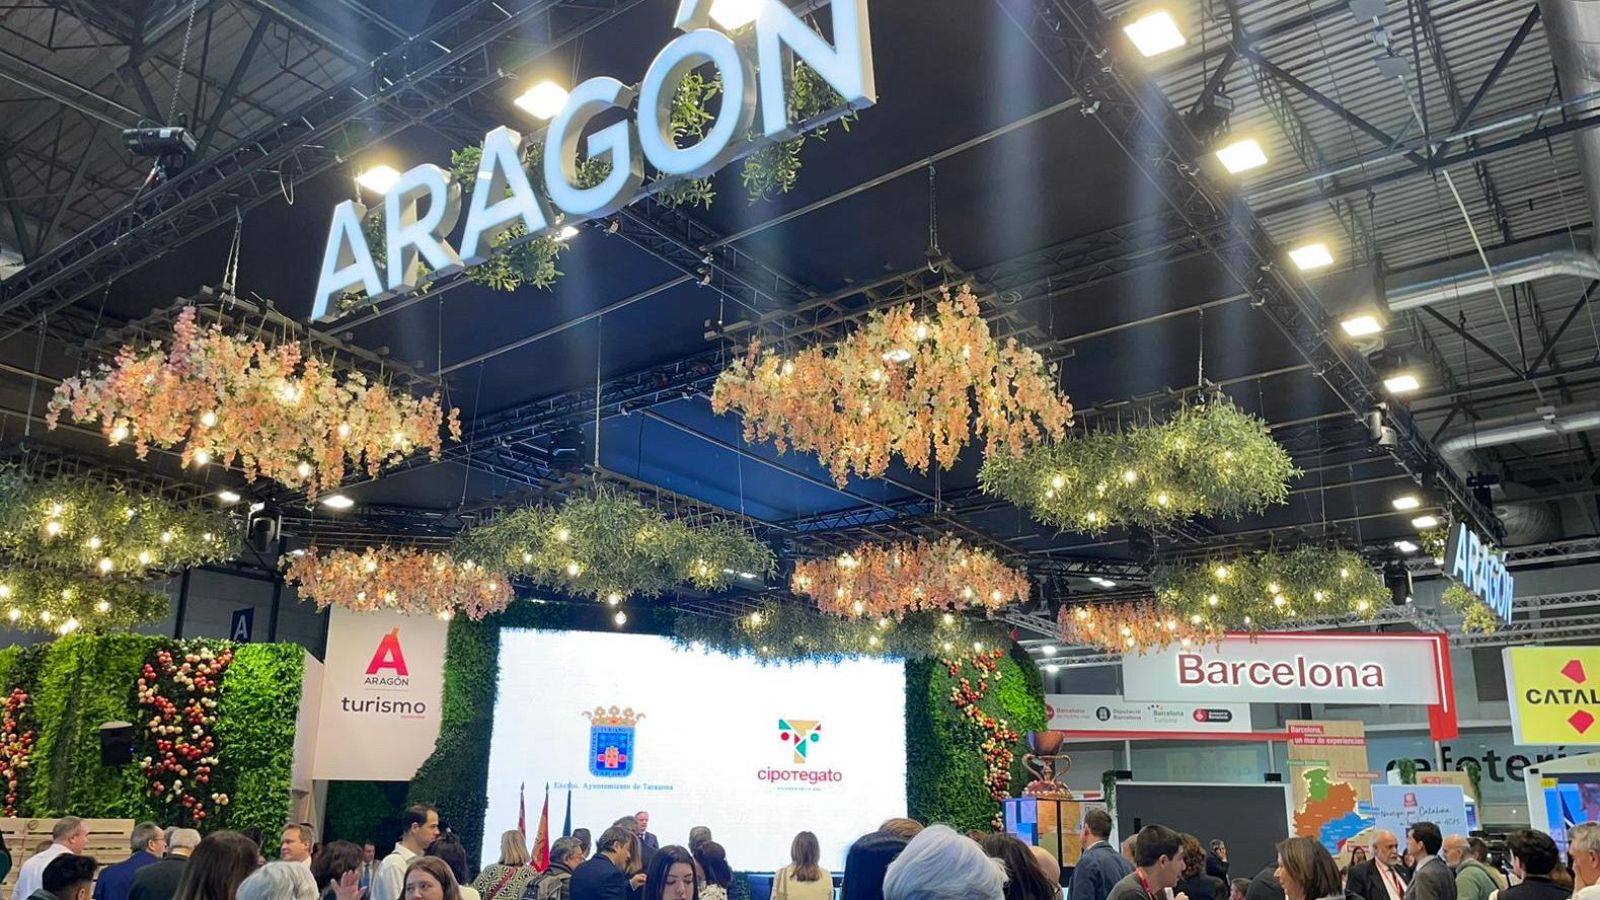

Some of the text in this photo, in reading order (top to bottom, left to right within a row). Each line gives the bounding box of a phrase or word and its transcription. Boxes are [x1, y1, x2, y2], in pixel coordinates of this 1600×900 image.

[311, 0, 875, 321] ARAGÓN
[233, 615, 248, 641] A
[1178, 654, 1384, 688] Barcelona
[341, 696, 426, 714] turismo
